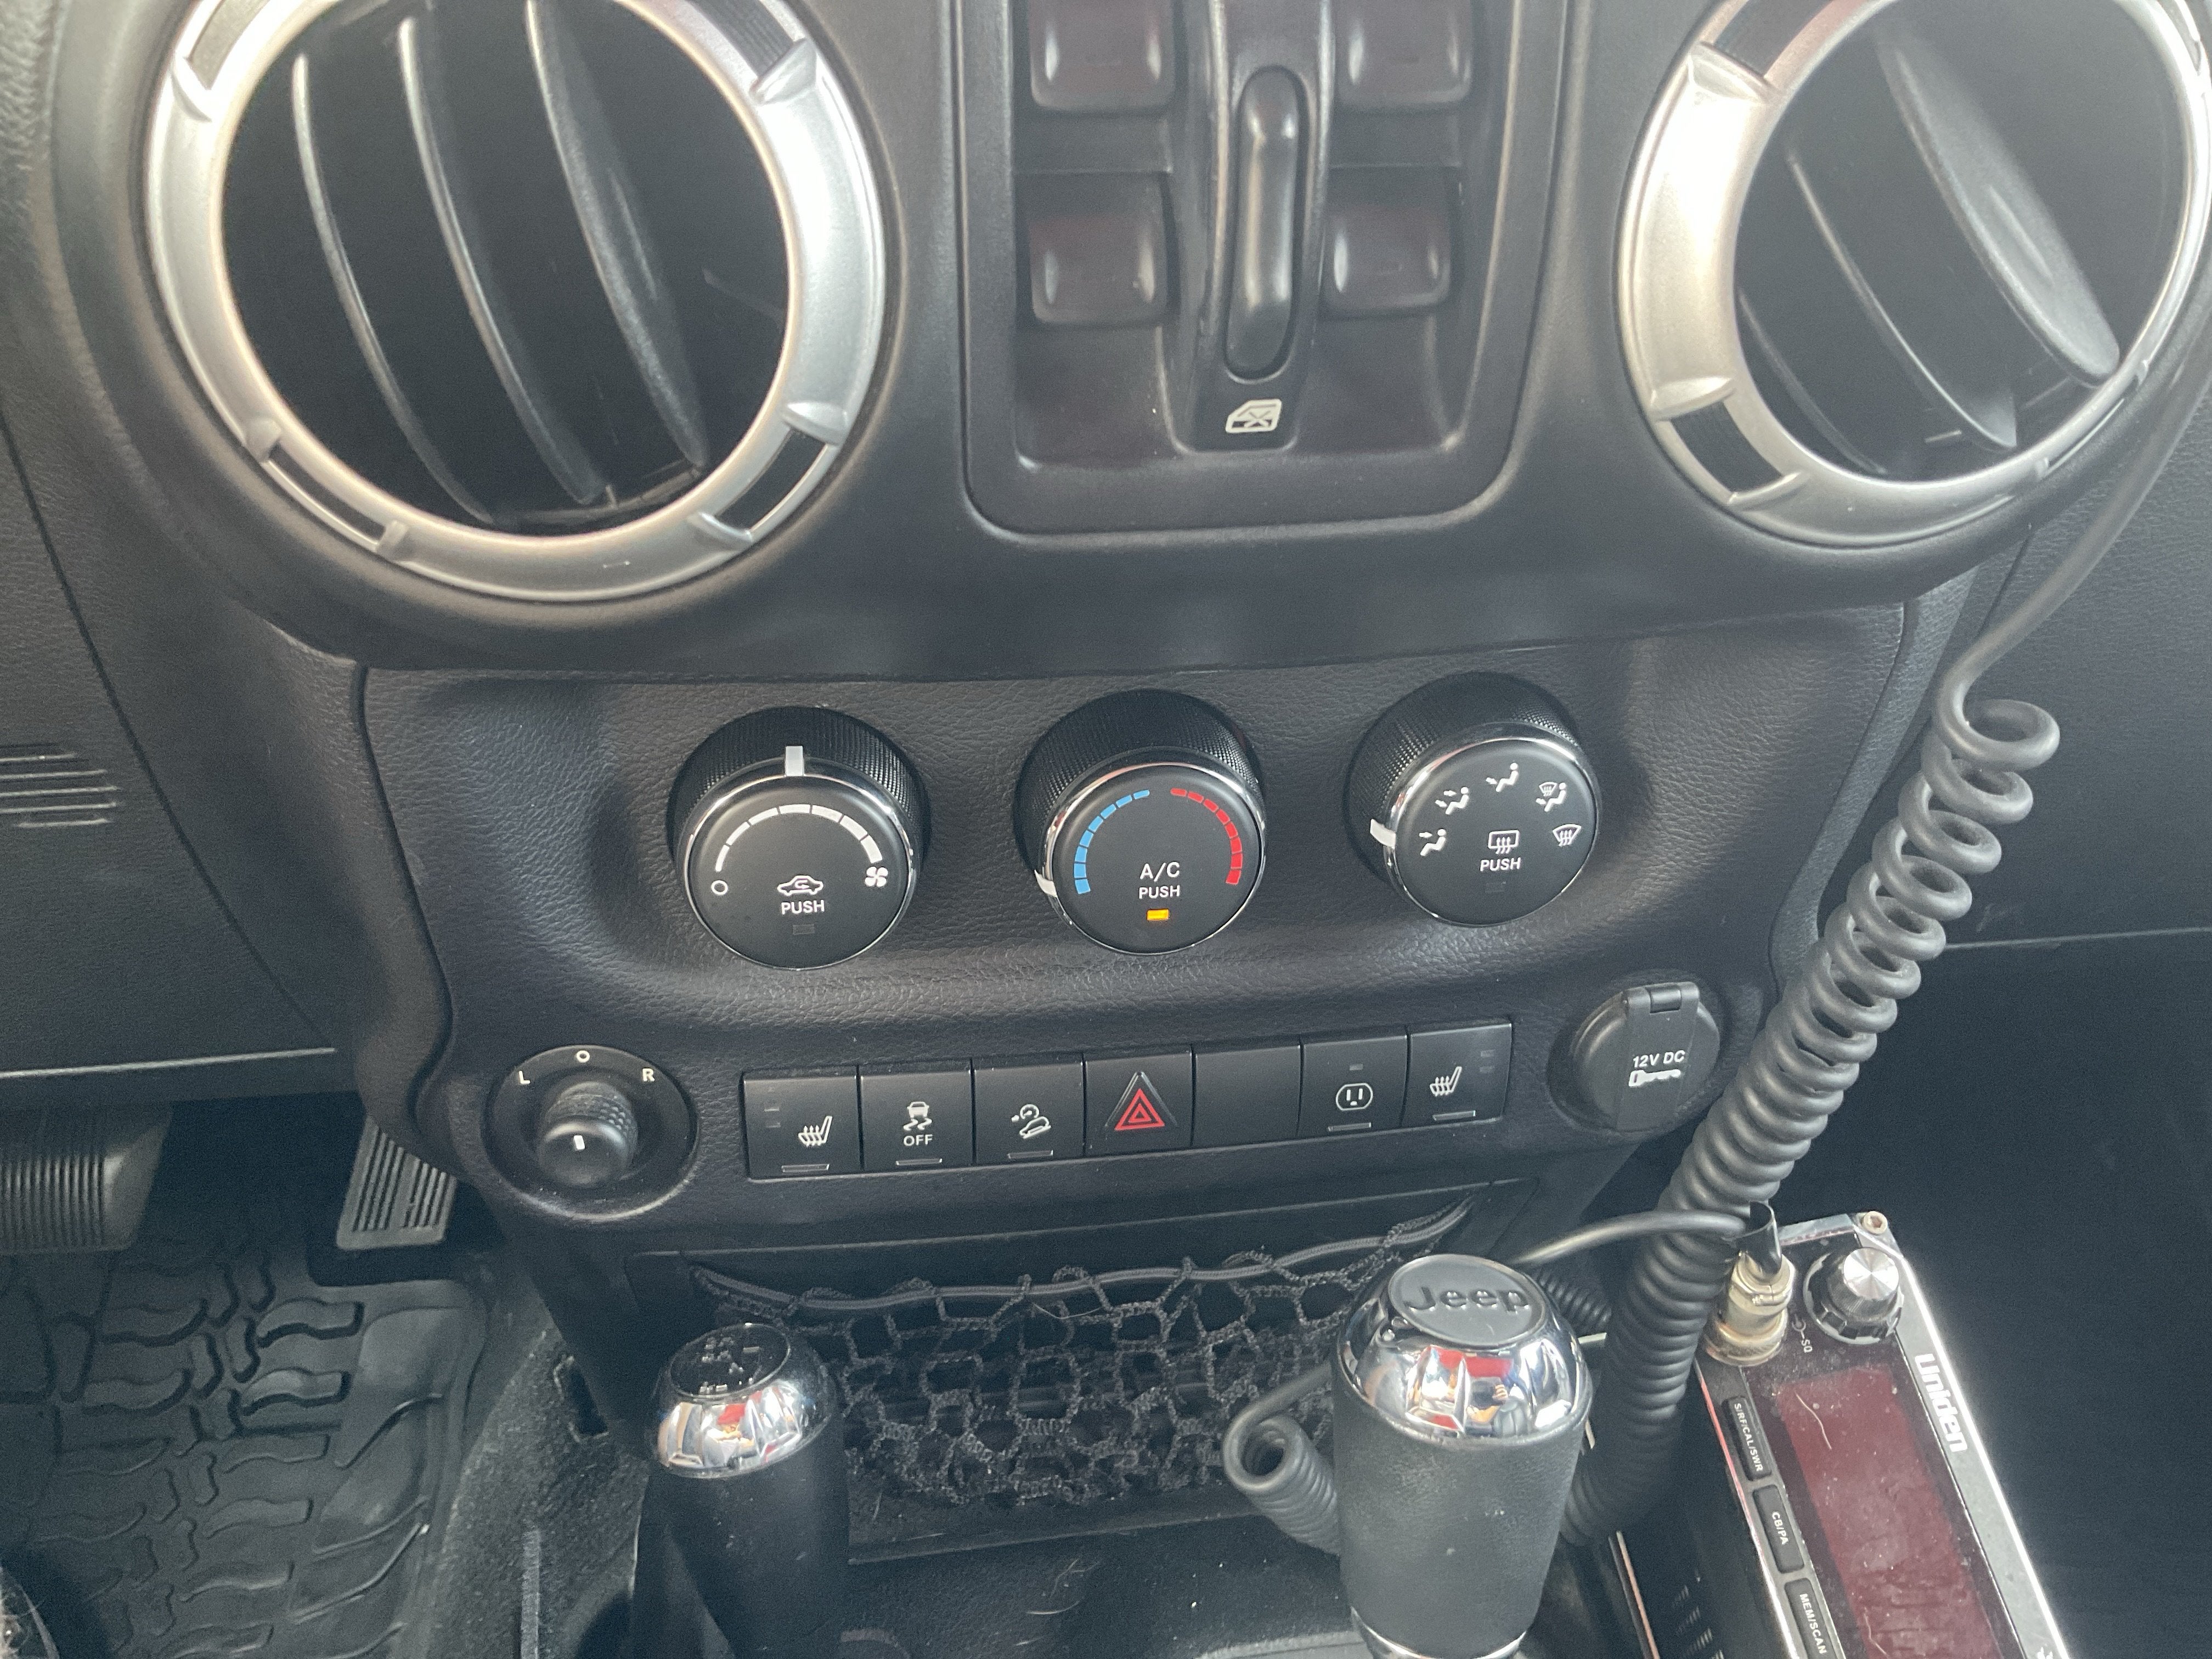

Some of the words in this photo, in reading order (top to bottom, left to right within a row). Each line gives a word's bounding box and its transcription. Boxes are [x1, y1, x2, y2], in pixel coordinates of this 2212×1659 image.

[1139, 861, 1180, 882] A/C
[1480, 857, 1521, 871] PUSH
[1138, 885, 1181, 899] PUSH
[781, 900, 825, 915] PUSH
[1633, 1053, 1660, 1068] 12V
[1663, 1049, 1685, 1064] DC
[518, 1070, 531, 1085] L
[642, 1068, 655, 1082] R
[903, 1134, 933, 1147] OFF
[1403, 1285, 1531, 1314] Jeep
[1914, 1353, 1968, 1452] Uniden
[1772, 1511, 1789, 1545] CB/PA
[1799, 1593, 1827, 1654] MEM/SCAN
